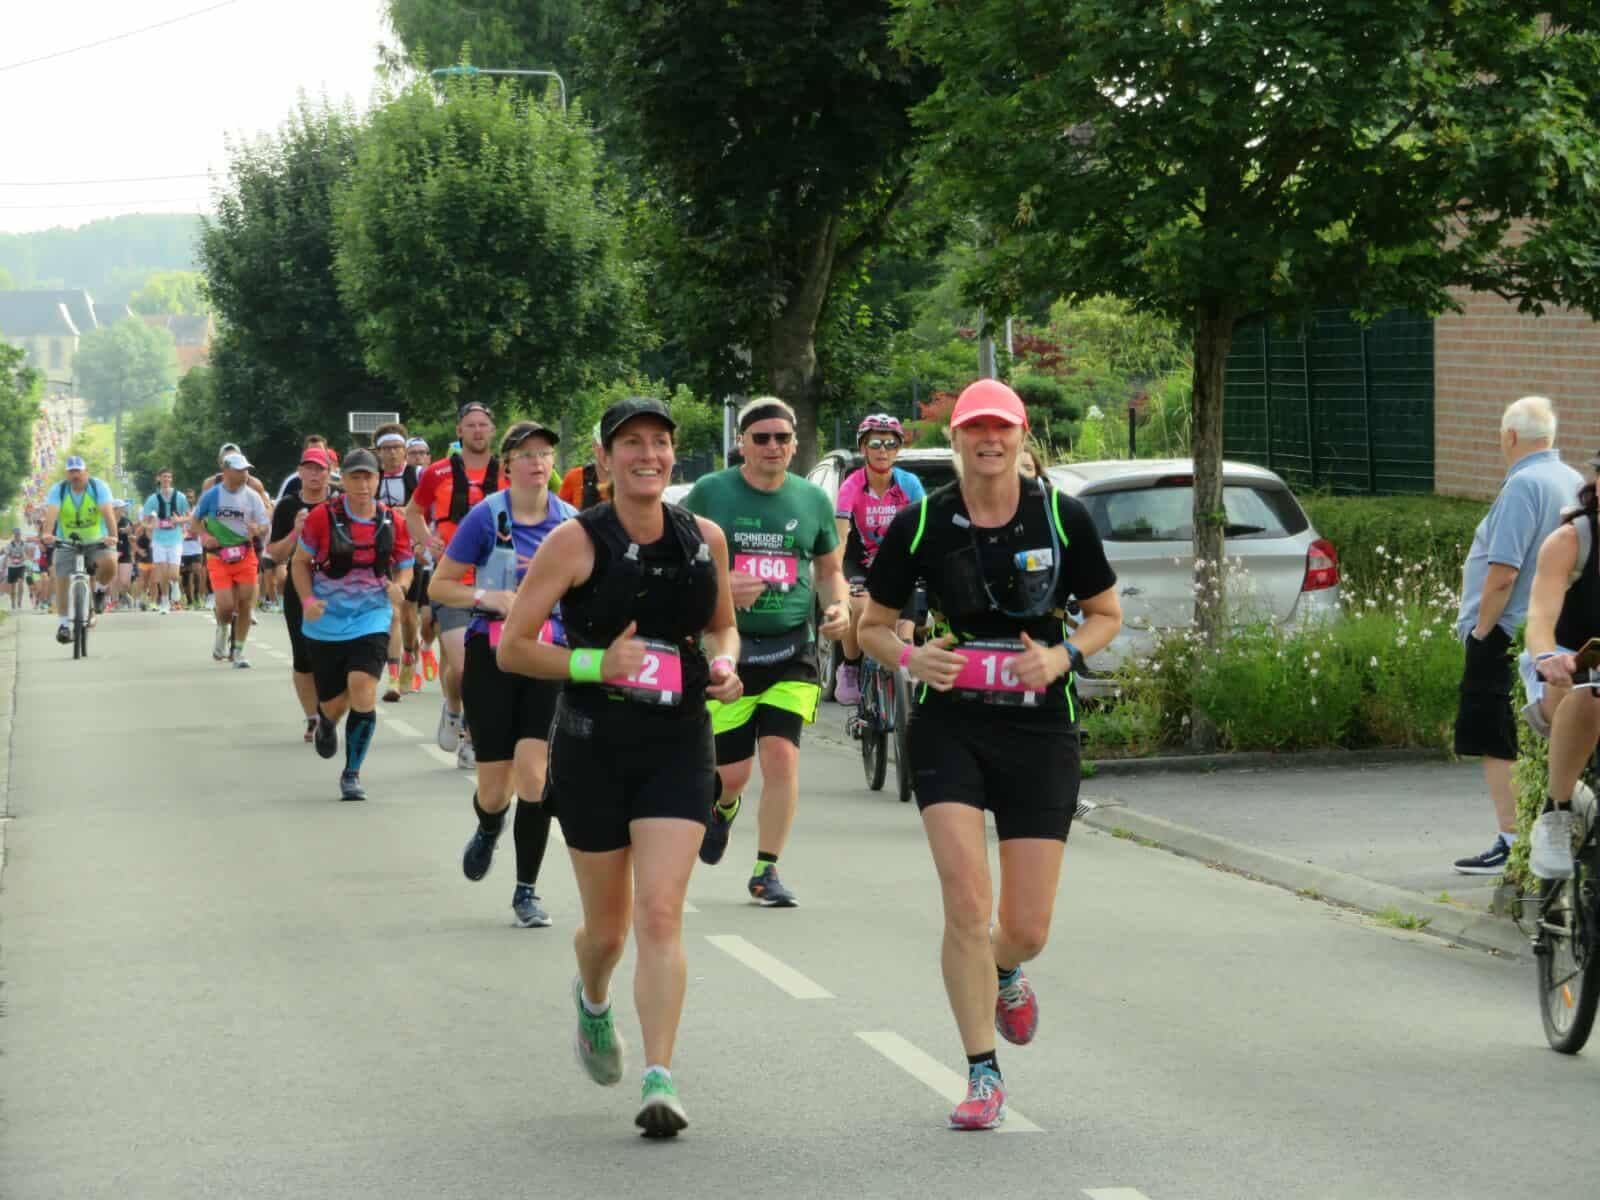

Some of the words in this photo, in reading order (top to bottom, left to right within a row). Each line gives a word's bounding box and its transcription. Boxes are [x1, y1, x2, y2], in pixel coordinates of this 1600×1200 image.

[866, 505, 897, 515] RACING
[734, 532, 784, 544] SCHNEIDER
[746, 557, 786, 580] 160
